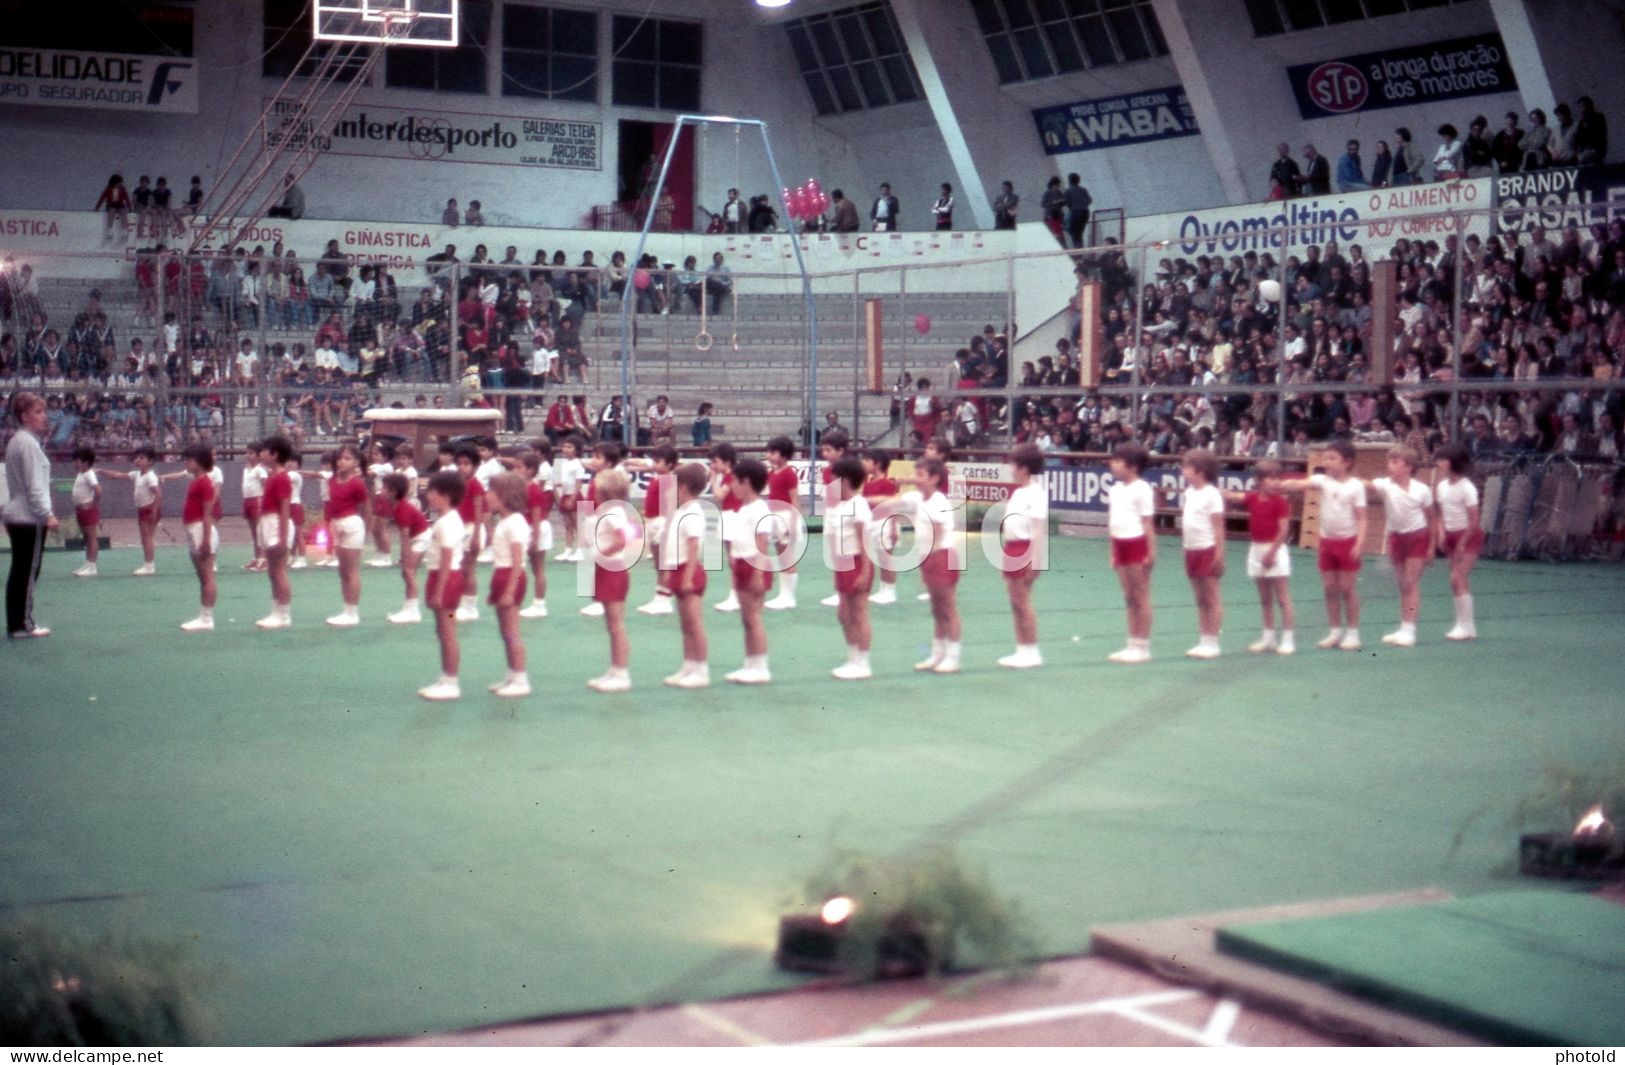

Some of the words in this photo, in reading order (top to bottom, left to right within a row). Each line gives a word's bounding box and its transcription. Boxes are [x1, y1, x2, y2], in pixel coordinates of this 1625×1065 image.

[1371, 63, 1383, 81] a
[1383, 56, 1428, 80] longa
[1430, 44, 1501, 73] duração
[39, 84, 143, 103] SEGURADOR
[1315, 67, 1361, 106] STP
[1384, 80, 1416, 100] dos
[1420, 67, 1500, 95] motores
[523, 120, 566, 136] GALERIAS
[1074, 105, 1183, 143] WABA
[552, 144, 596, 160] ARCO-IRIS
[1497, 169, 1579, 197] BRANDY
[1369, 194, 1381, 211] O
[1388, 184, 1478, 210] ALIMENTO
[1180, 200, 1360, 255] Ovomaltine
[962, 466, 1000, 480] carnes
